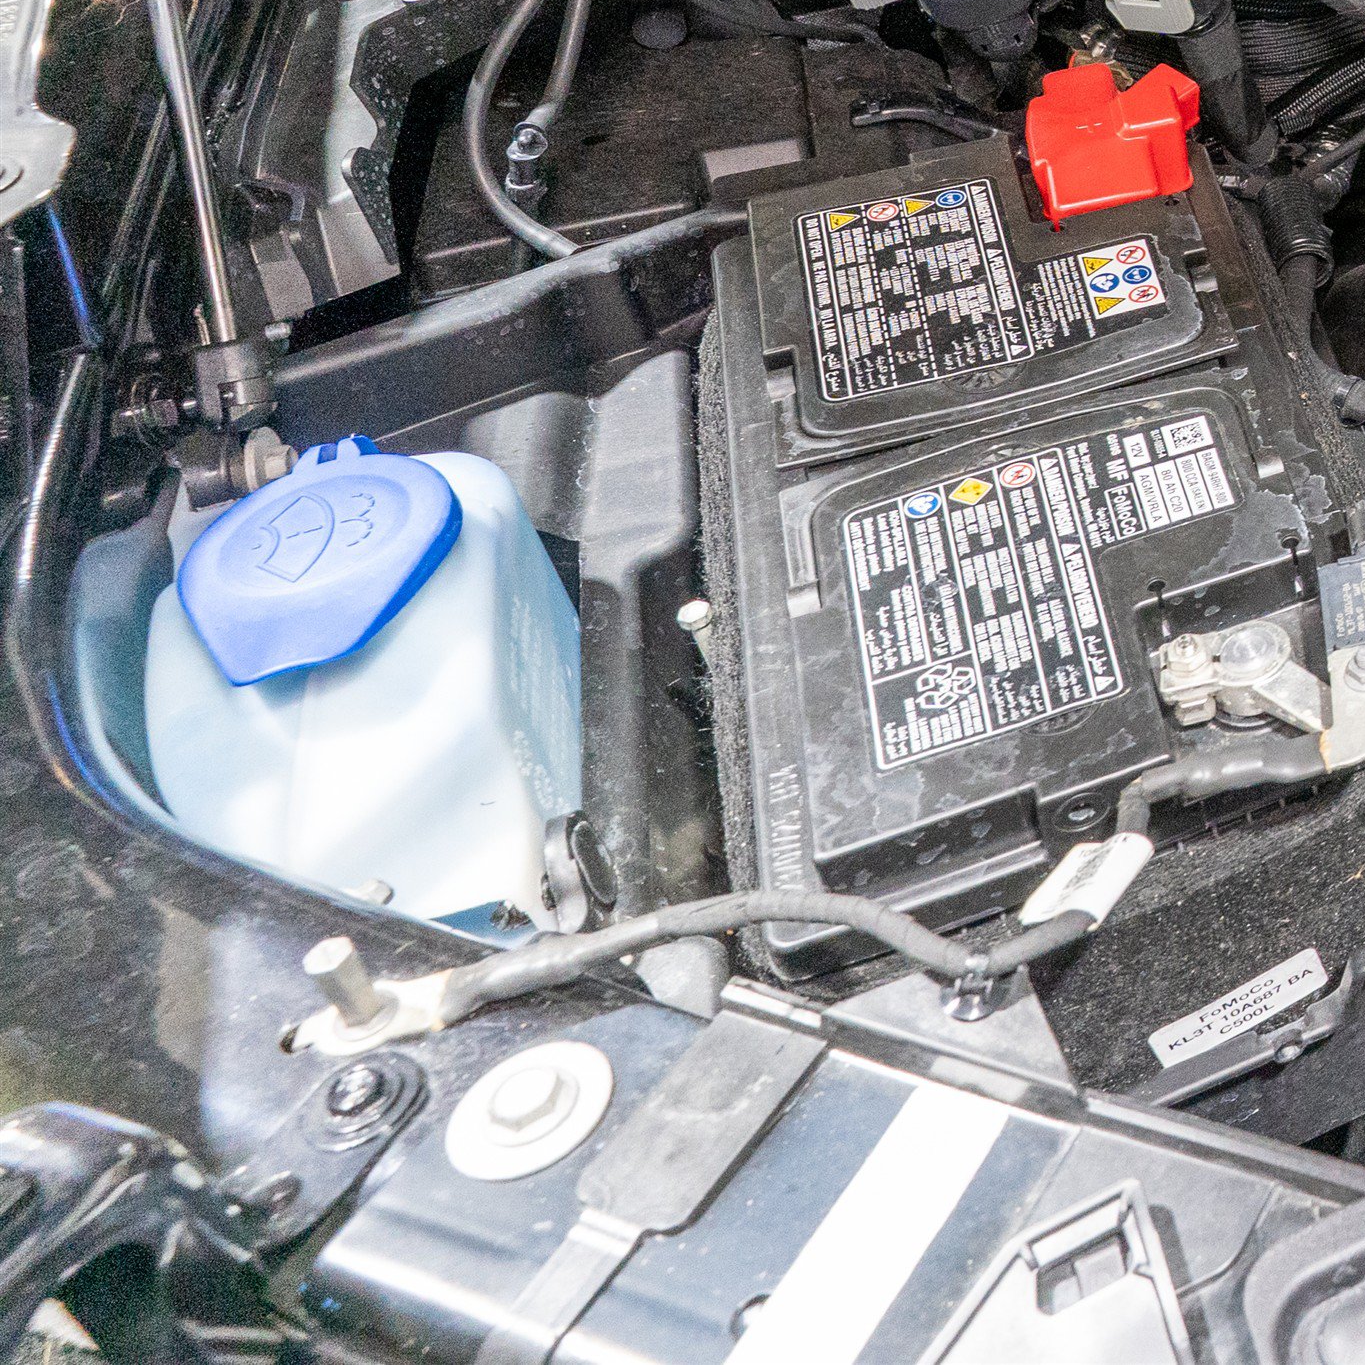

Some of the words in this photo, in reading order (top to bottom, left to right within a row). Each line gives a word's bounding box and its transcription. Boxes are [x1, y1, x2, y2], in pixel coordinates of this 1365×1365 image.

[805, 217, 818, 228] DO
[972, 192, 997, 243] DANGER/POISON
[806, 226, 820, 241] NOT
[812, 260, 825, 271] NE
[813, 269, 827, 283] PAS
[987, 255, 1016, 311] PELIGRO/VENENO
[819, 308, 833, 319] NO
[821, 318, 835, 328] LA
[1129, 441, 1144, 459] 12V
[1105, 457, 1130, 483] MF
[1160, 468, 1172, 481] 80
[1180, 458, 1194, 473] 800
[1164, 481, 1177, 494] Ah
[1184, 472, 1199, 487] CCA
[1041, 465, 1075, 537] DANGER/POISON
[1138, 472, 1162, 523] AGM/VRLA
[1168, 494, 1184, 513] C20
[1110, 486, 1139, 536] FoMoCo
[1063, 551, 1099, 630] PELIGRO/VENENO
[1167, 1020, 1215, 1051] KL3T
[1219, 983, 1284, 1022] 10A687
[1286, 966, 1314, 986] BA
[1197, 976, 1276, 1023] FoMoCo
[1217, 1000, 1275, 1035] C500L
